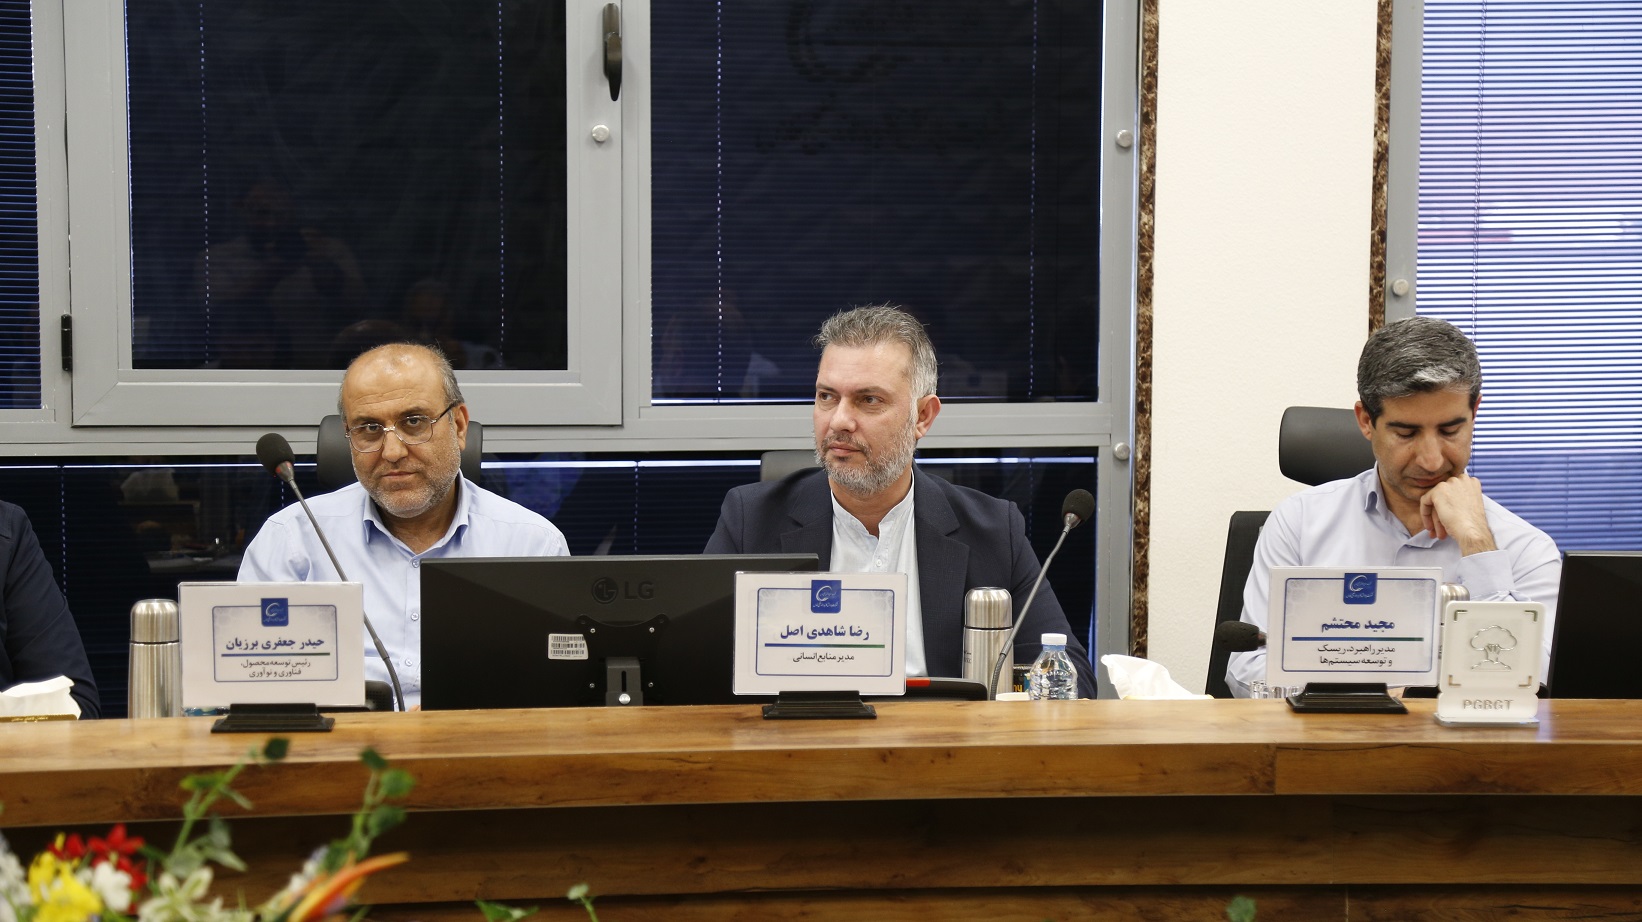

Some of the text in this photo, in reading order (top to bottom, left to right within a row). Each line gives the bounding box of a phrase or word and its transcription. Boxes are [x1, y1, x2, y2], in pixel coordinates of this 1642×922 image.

[624, 581, 655, 600] LG
[1321, 617, 1395, 633] مجید محتشم
[780, 625, 870, 640] رضا شاهدی اصل
[261, 636, 296, 650] جعفری
[299, 638, 325, 650] حیدر
[1317, 643, 1346, 655] ریسک
[1375, 645, 1396, 655] مدیر
[291, 658, 311, 668] رئیس
[792, 652, 855, 663] مدیر منابع انسانی
[1361, 657, 1388, 667] توسعه
[270, 659, 291, 668] توسعه
[249, 667, 273, 678] نوآوری
[278, 668, 302, 678] فناوری
[1463, 699, 1514, 710] PGBGT
